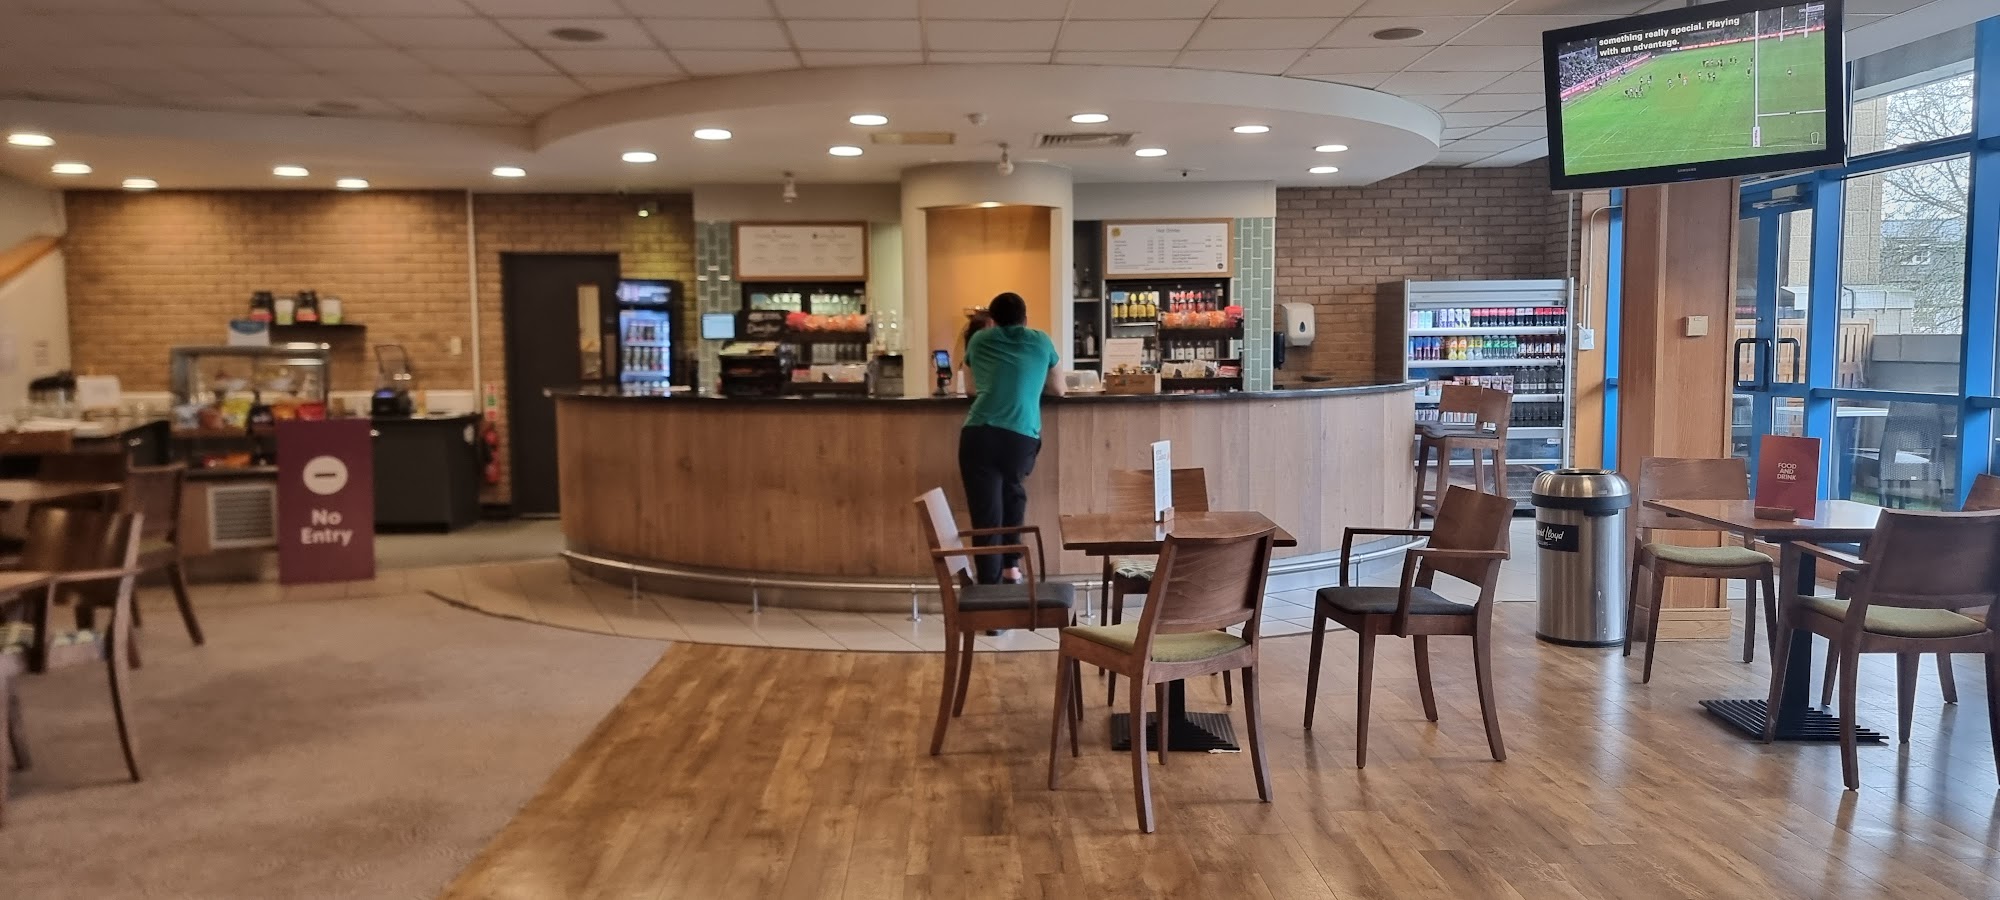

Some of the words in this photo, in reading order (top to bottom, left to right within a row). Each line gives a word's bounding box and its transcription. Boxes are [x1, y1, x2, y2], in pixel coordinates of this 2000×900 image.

[1598, 33, 1643, 46] something
[1645, 28, 1669, 39] really
[1671, 22, 1704, 35] special.
[1706, 17, 1740, 28] Playing
[1599, 47, 1619, 57] with
[1620, 46, 1631, 54] an
[1633, 39, 1680, 51] advantage.
[311, 508, 343, 526] No
[300, 527, 354, 547] Entry
[1545, 526, 1564, 542] Lloyd
